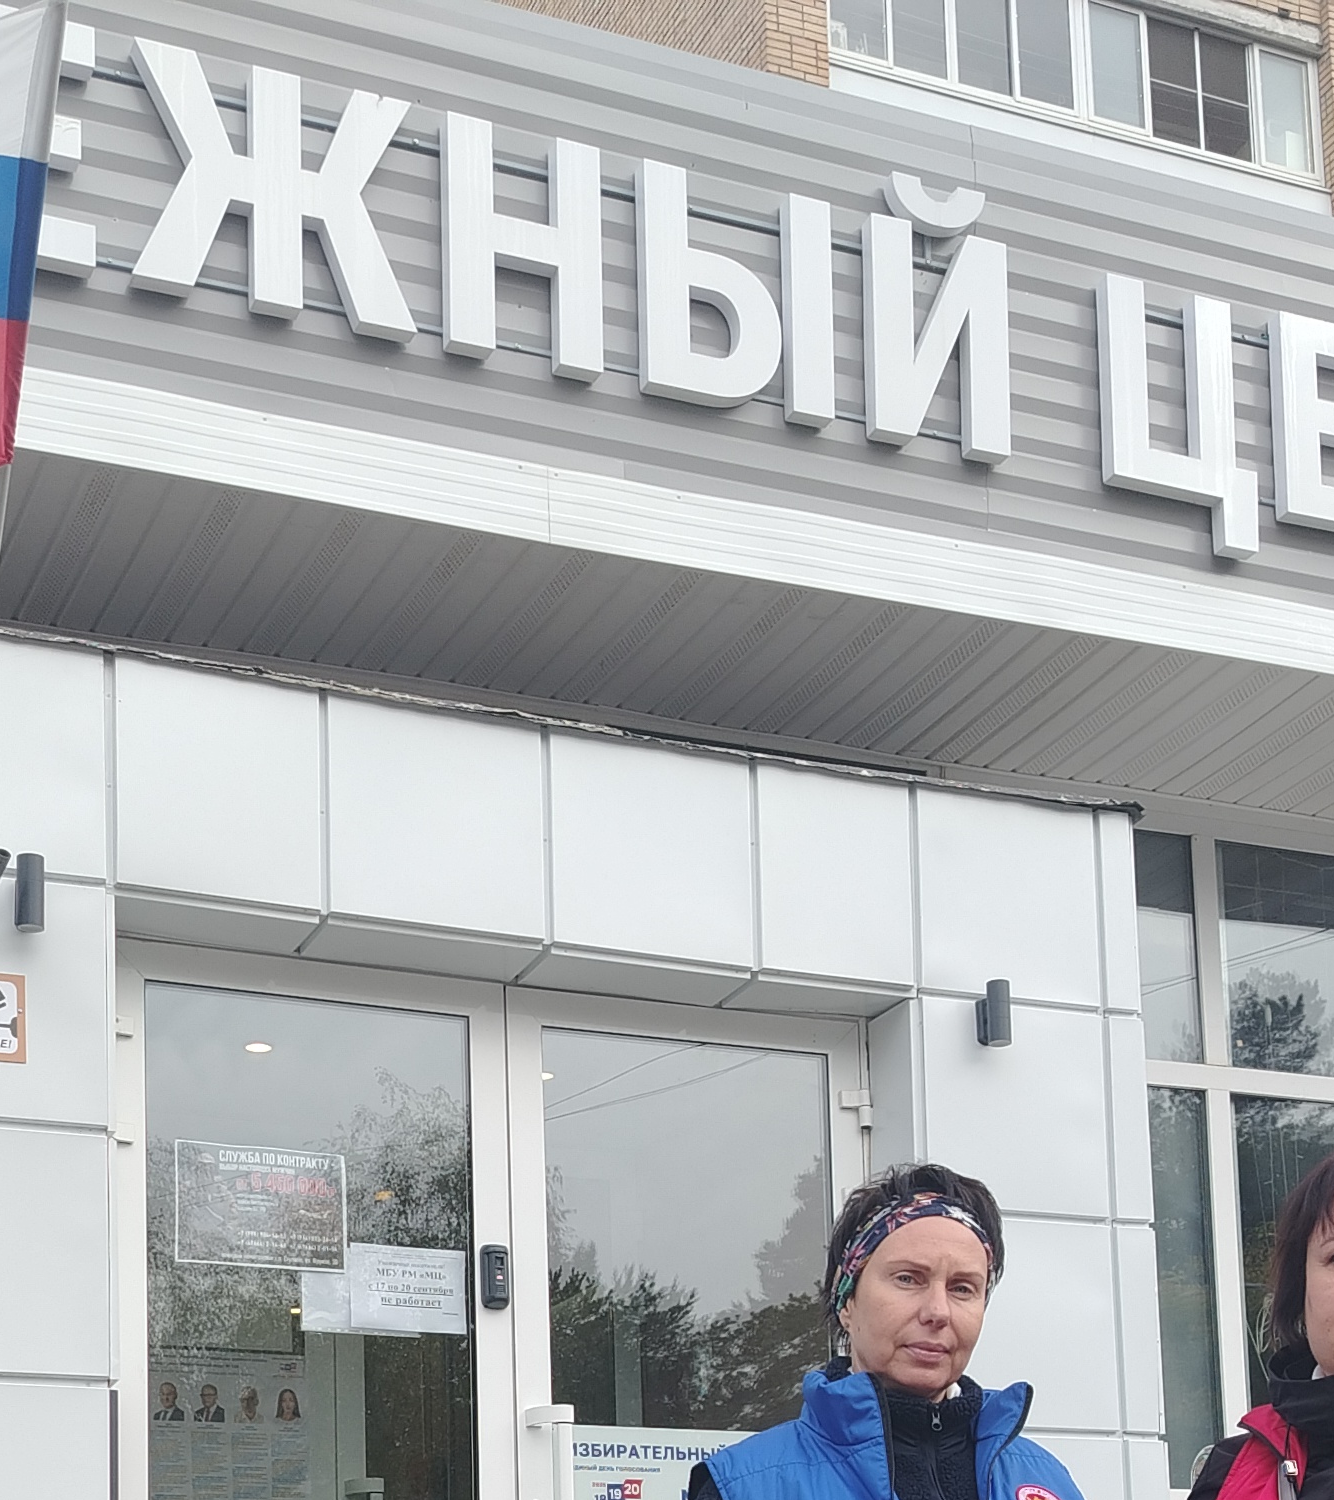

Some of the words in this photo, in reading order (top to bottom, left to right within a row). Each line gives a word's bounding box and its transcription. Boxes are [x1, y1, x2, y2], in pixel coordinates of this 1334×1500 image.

[219, 1150, 260, 1163] СЛУЖБА
[263, 1153, 275, 1165] ПО
[277, 1155, 328, 1170] КОНТРАКТУ
[251, 1171, 261, 1192] 5
[266, 1173, 295, 1194] 450
[376, 1268, 399, 1278] МБУ
[402, 1270, 417, 1279] РМ
[419, 1271, 447, 1281] «МЦ»
[376, 1282, 386, 1290] 17
[401, 1284, 411, 1292] 20
[413, 1287, 453, 1295] сентября
[381, 1296, 393, 1304] не
[395, 1297, 441, 1306] работает
[608, 1488, 622, 1500] 19
[624, 1483, 640, 1496] 20
